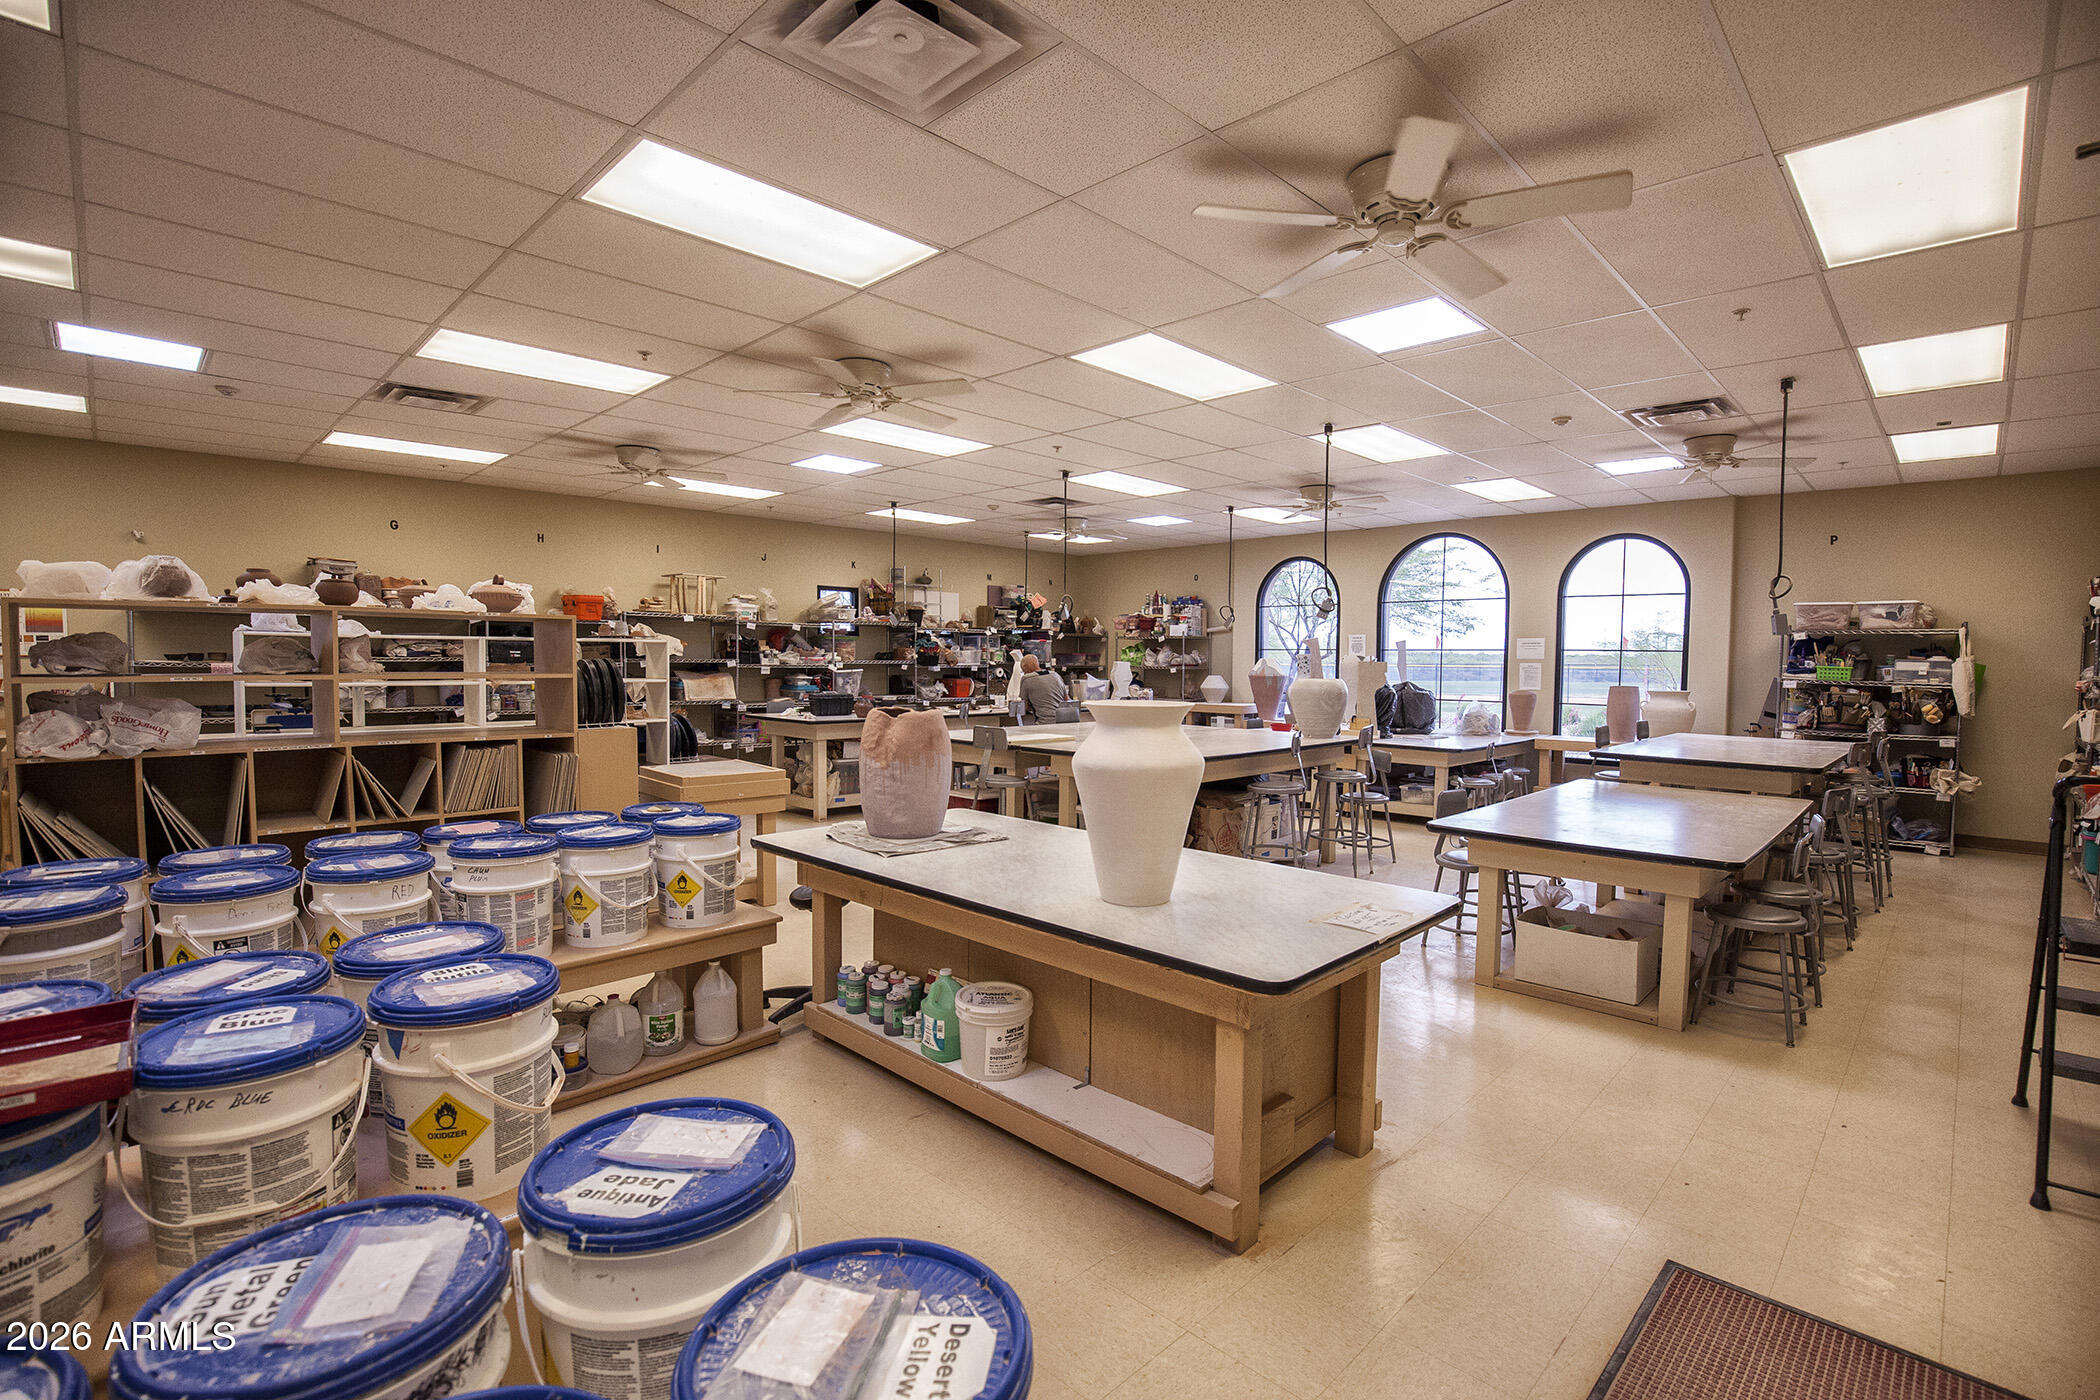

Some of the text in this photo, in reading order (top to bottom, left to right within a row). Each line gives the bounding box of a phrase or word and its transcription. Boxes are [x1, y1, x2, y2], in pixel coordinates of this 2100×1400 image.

[389, 519, 399, 530] G
[536, 533, 545, 543] H
[1830, 535, 1838, 545] P
[760, 553, 767, 562] J
[851, 561, 857, 569] K
[110, 715, 169, 738] HomeGoods
[391, 884, 415, 900] RED
[431, 964, 478, 976] Blue
[221, 1008, 289, 1022] Croc
[218, 1016, 283, 1030] Blue
[228, 1091, 274, 1110] BLUE
[427, 1130, 468, 1140] OXIDIZER
[602, 1174, 676, 1190] Jade
[577, 1188, 670, 1208] Antique
[248, 1257, 314, 1329] Green
[895, 1322, 941, 1399] Yellow
[928, 1323, 971, 1399] Desert
